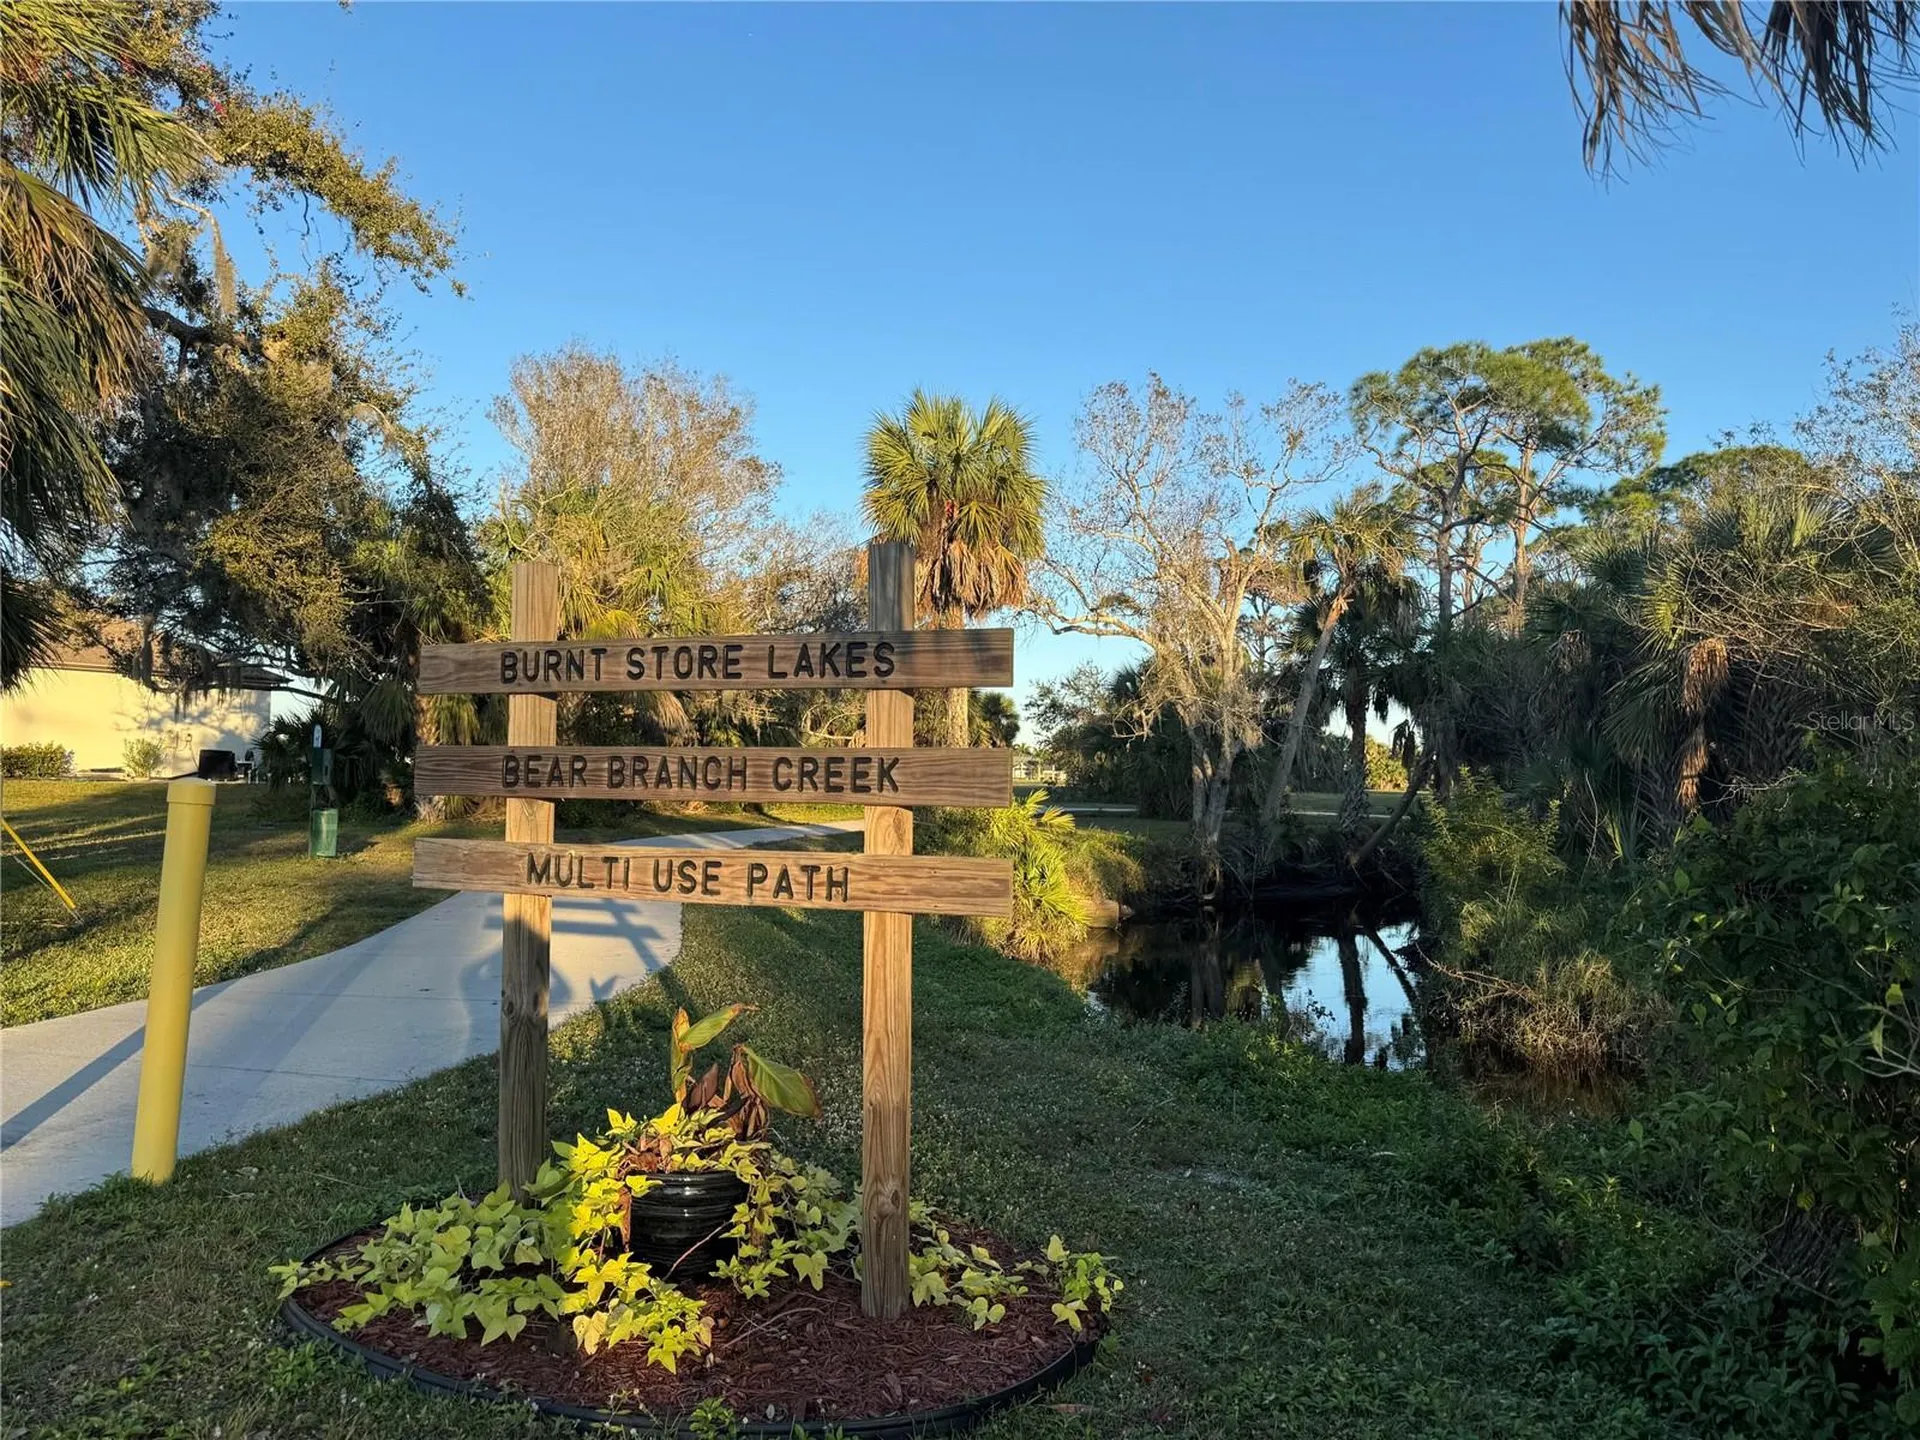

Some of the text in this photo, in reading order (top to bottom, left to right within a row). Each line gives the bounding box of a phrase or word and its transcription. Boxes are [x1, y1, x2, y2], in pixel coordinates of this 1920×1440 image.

[501, 641, 896, 684] BURNT STORE LAKES
[502, 754, 900, 793] BEAR BRANCH CREEK
[527, 852, 849, 902] MULTI USE PATH
